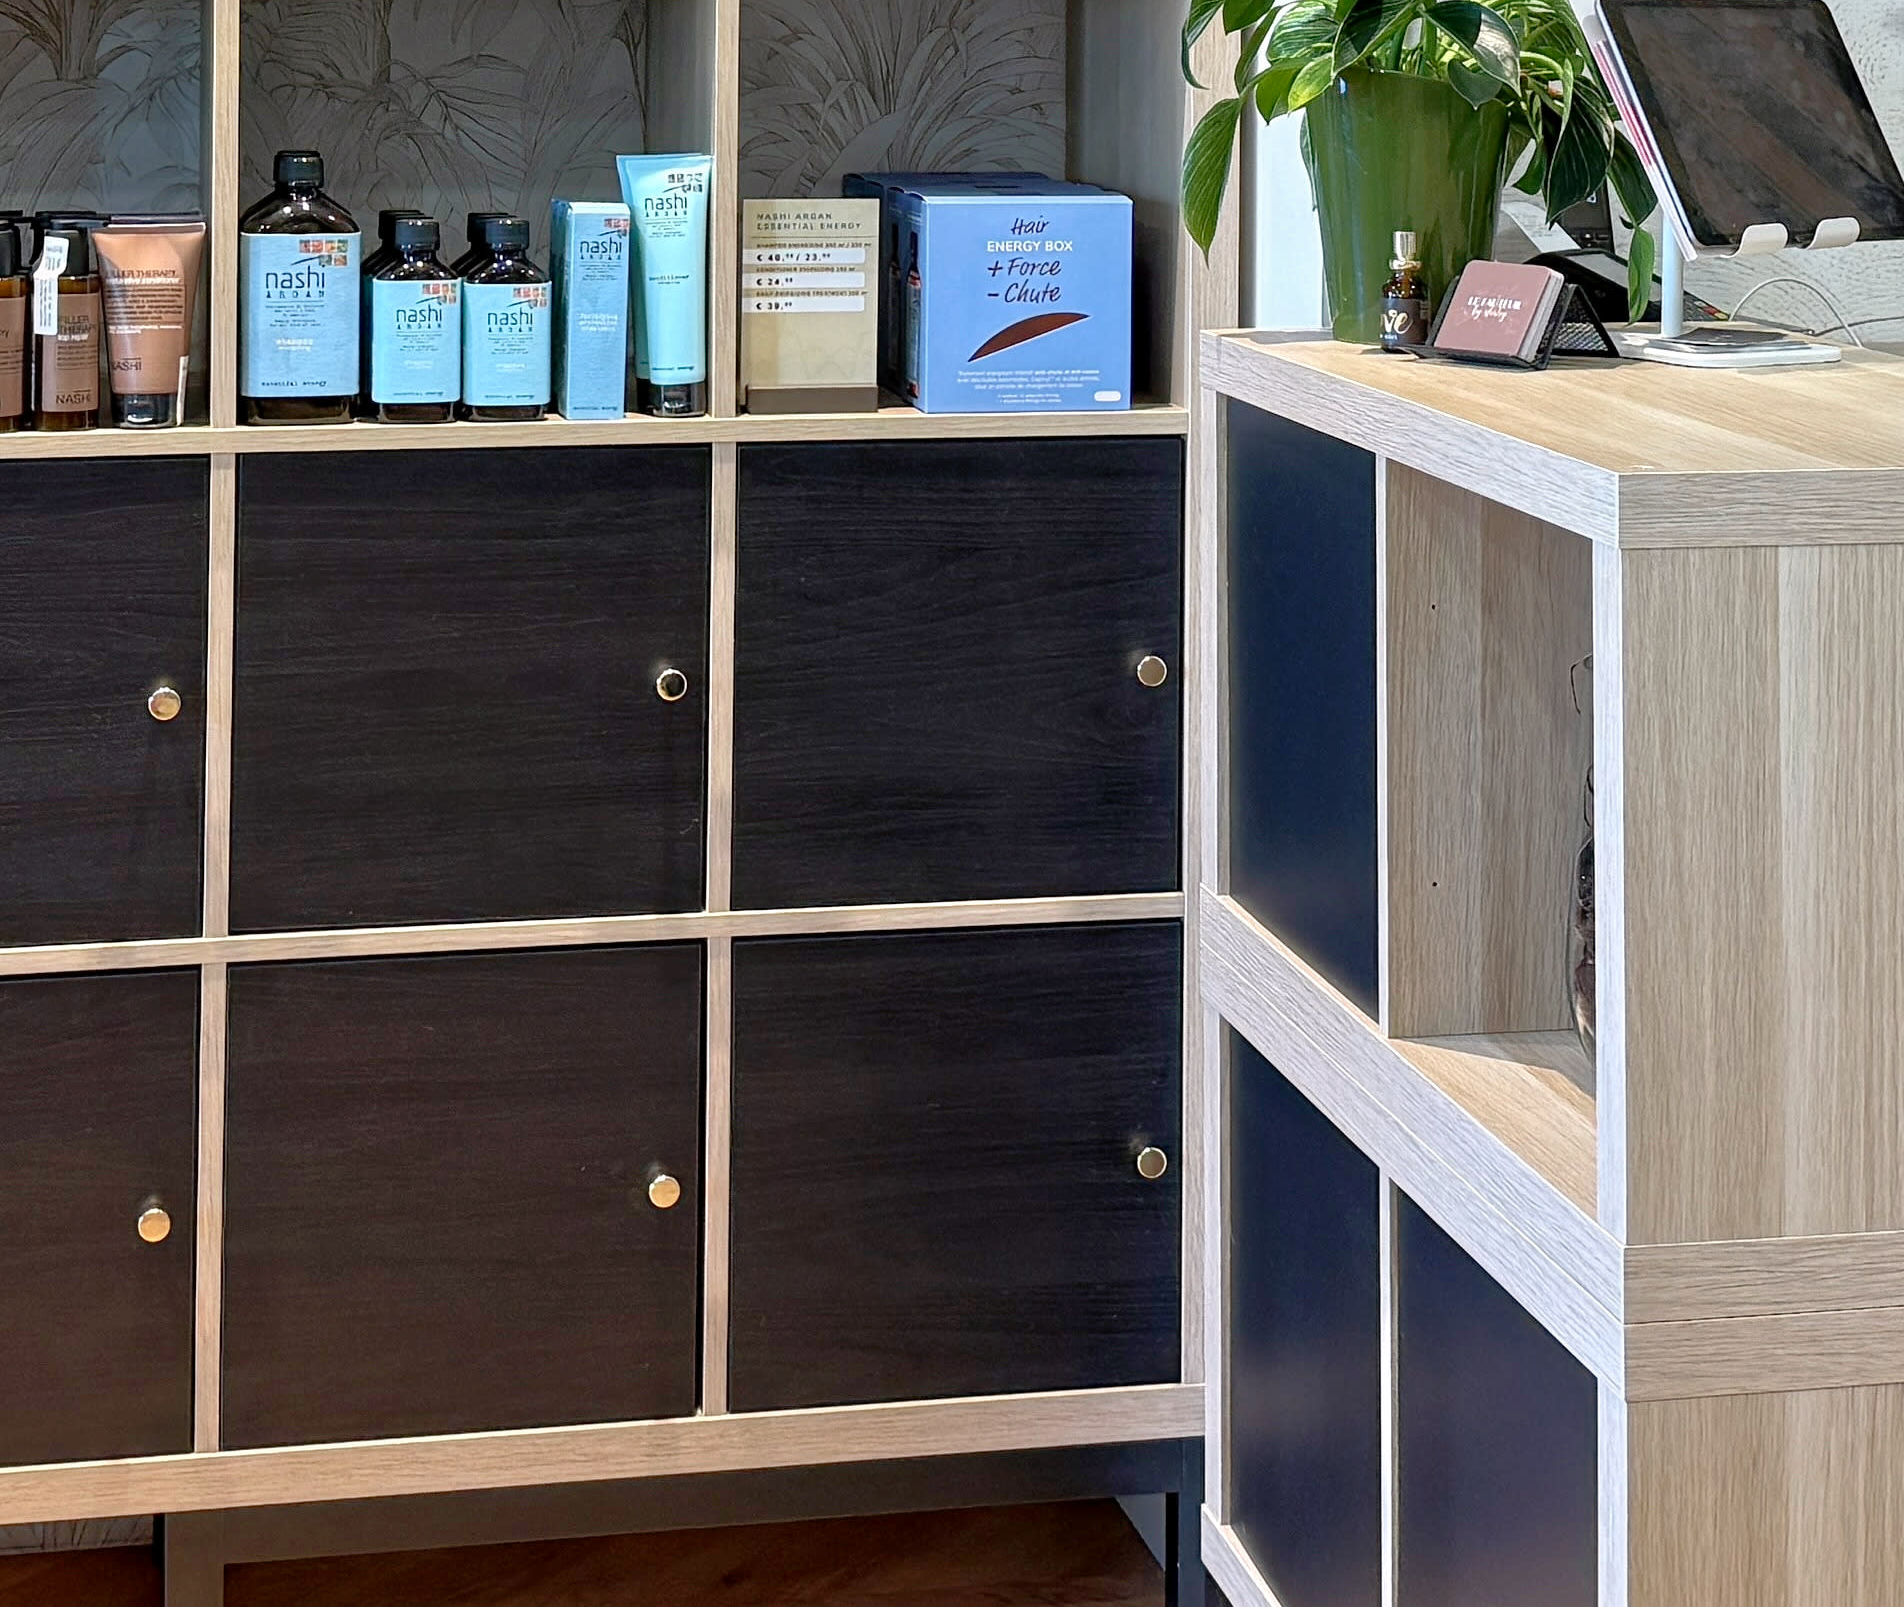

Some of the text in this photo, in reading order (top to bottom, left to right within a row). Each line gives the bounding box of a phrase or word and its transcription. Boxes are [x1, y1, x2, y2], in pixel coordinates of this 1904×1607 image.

[645, 193, 688, 210] nashi
[757, 212, 833, 221] NASHI ARGAN
[1010, 214, 1050, 235] Hair
[757, 222, 861, 231] ESSENTIAL ENERGY
[580, 237, 622, 254] nashi
[987, 240, 1073, 252] ENERGY BOX
[987, 256, 1062, 277] + Force
[265, 265, 325, 288] nashi
[1004, 278, 1062, 304] Chute
[396, 302, 442, 323] nashi
[487, 306, 533, 325] nashi
